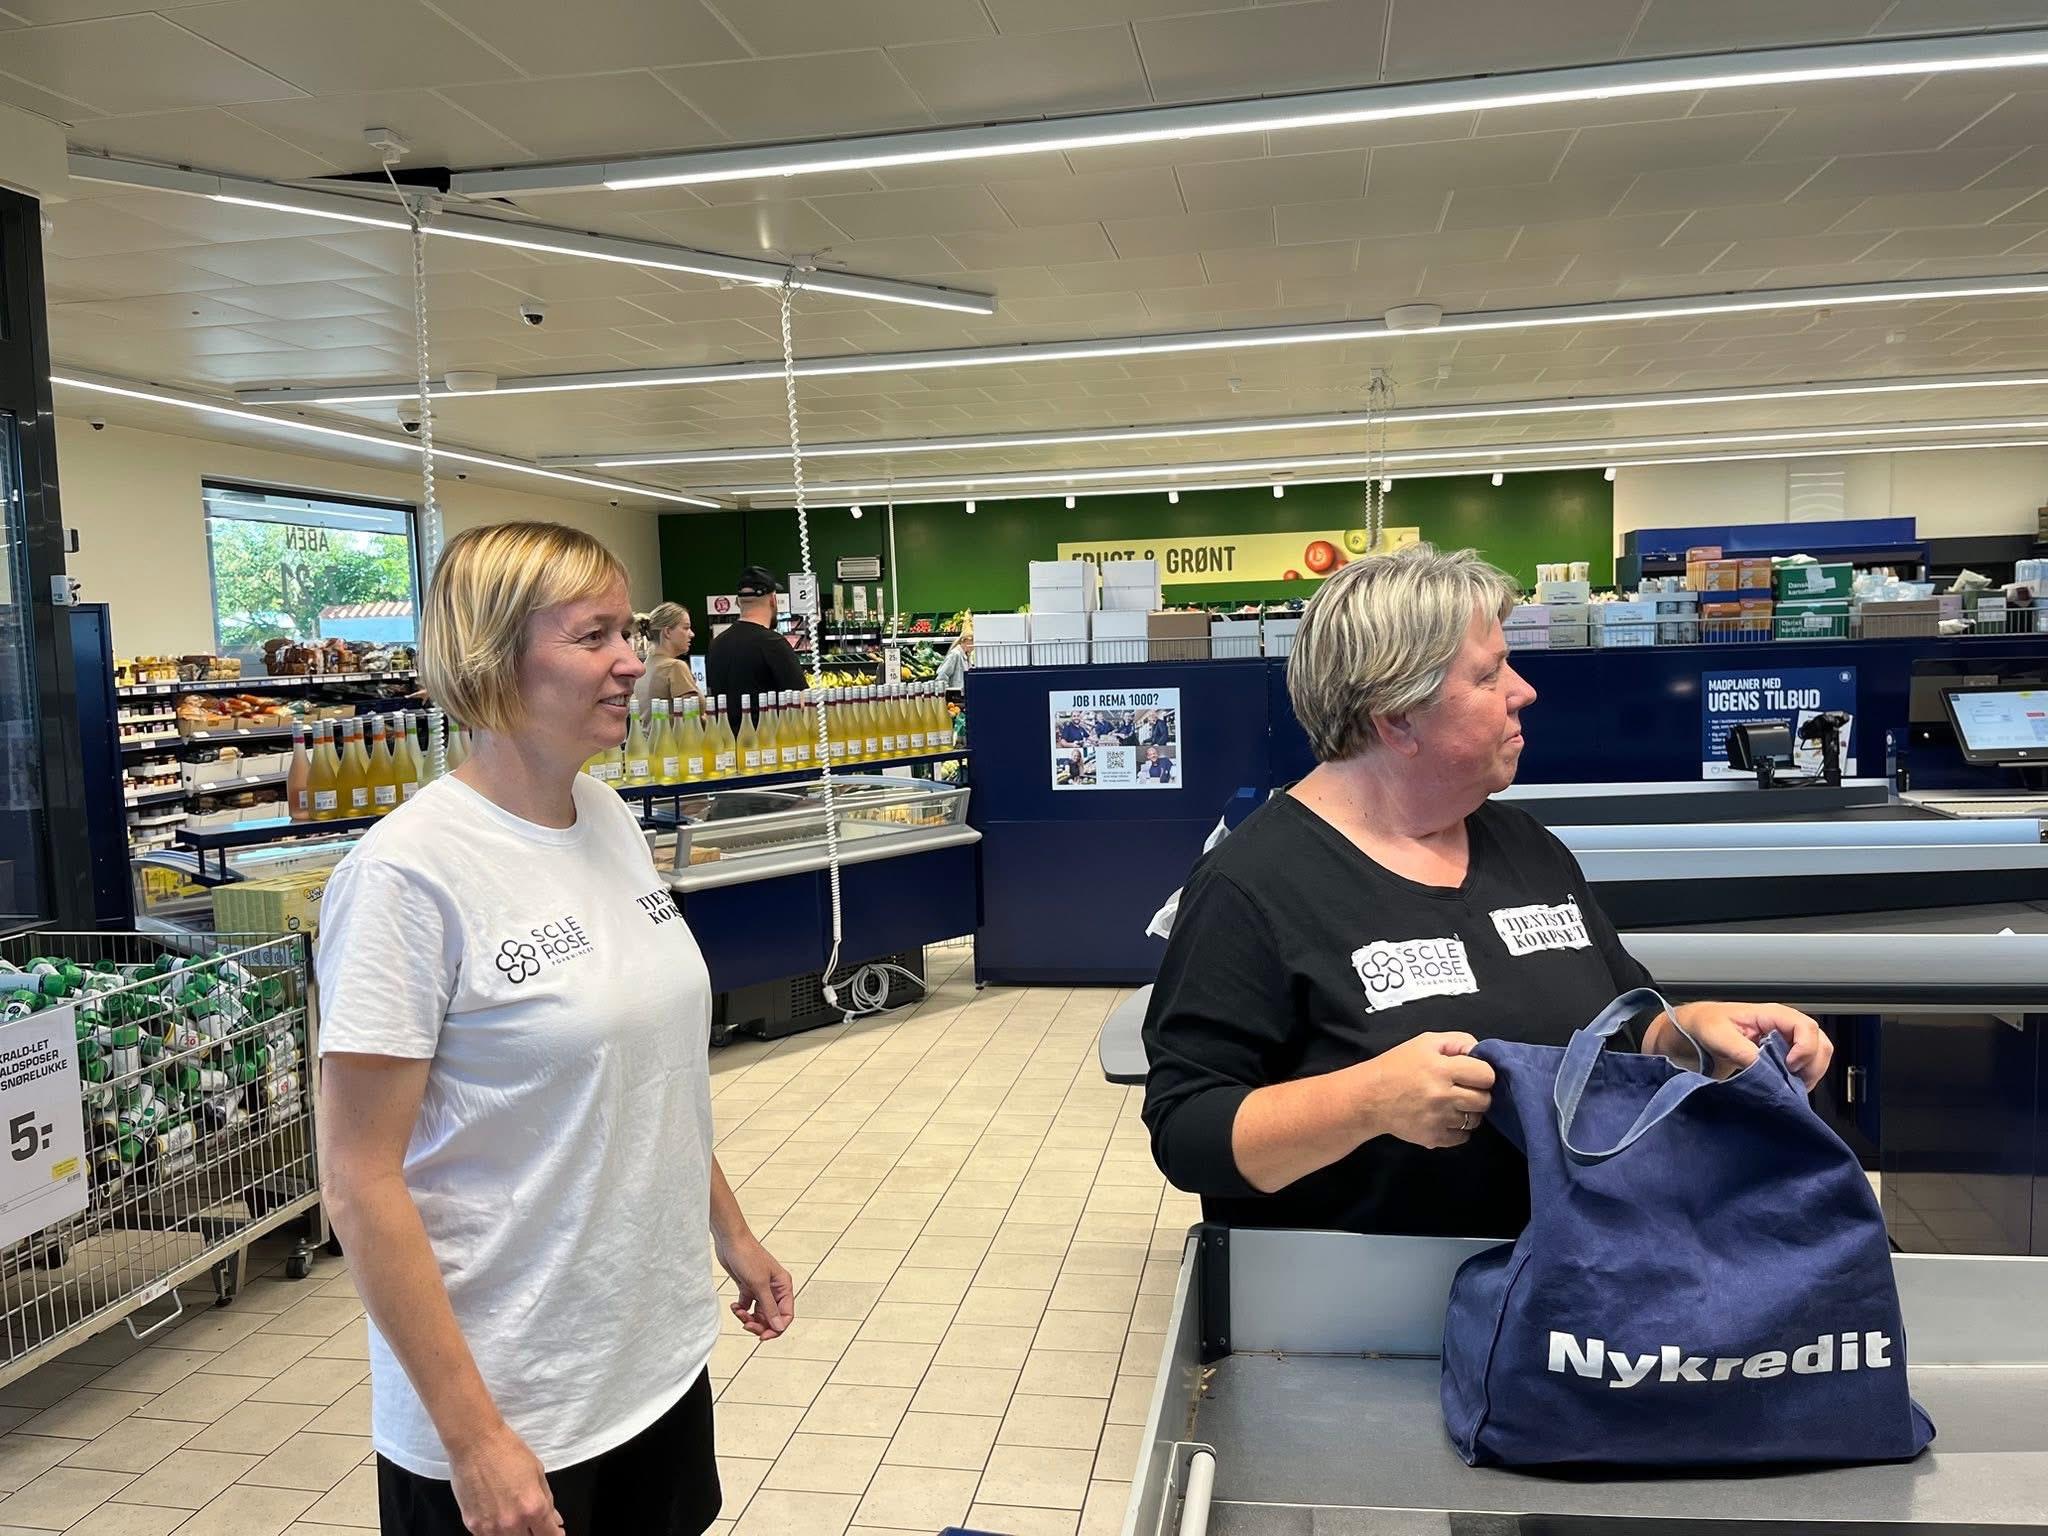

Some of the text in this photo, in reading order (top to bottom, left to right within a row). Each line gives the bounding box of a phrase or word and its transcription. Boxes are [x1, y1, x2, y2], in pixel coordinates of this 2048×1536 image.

[1166, 546, 1236, 574] GRØNT
[1708, 677, 1781, 691] MADPLANER MED
[1072, 693, 1159, 707] JOB I REMA 1000?
[1708, 689, 1821, 712] UGENS TILBUD
[531, 916, 581, 942] SCLE
[1512, 925, 1585, 948] KORPSET
[541, 931, 590, 959] ROSE
[1403, 942, 1460, 963] SCLE
[1409, 960, 1465, 979] ROSE
[0, 1059, 68, 1091] SNØRELUKKE
[1548, 1331, 1891, 1389] Nykredit
